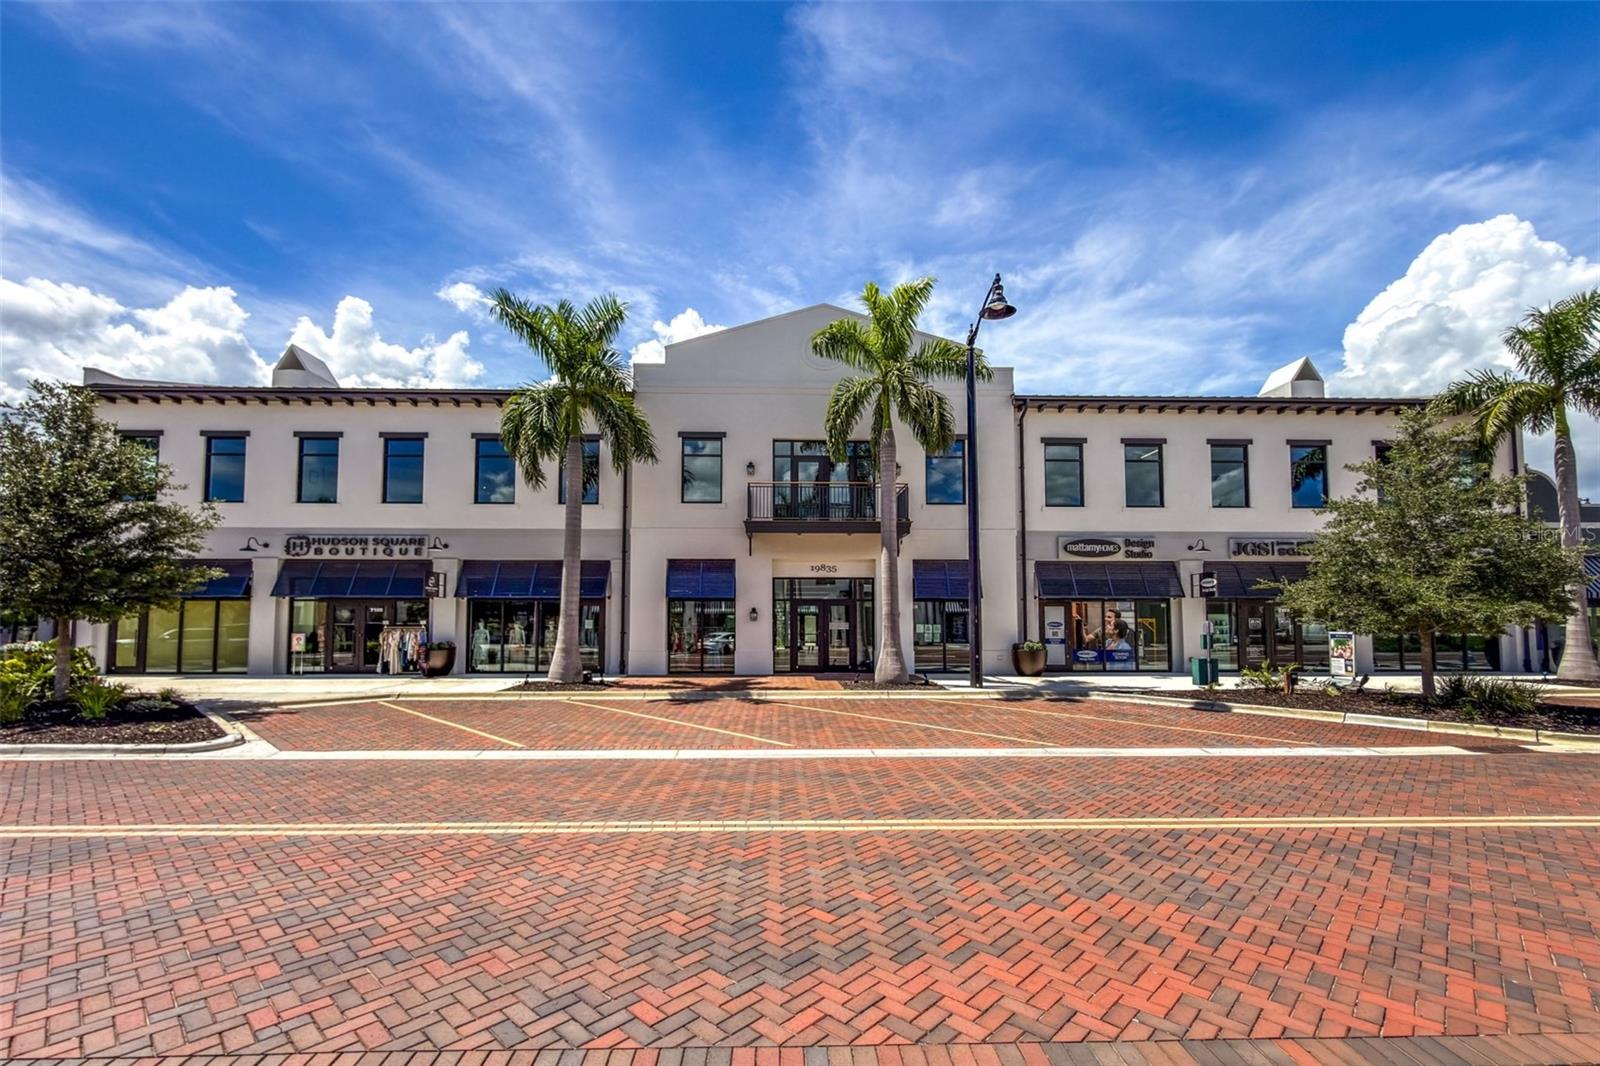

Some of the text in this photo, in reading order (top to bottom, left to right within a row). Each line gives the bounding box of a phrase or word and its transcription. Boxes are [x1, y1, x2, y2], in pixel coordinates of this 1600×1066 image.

[311, 537, 425, 547] HUDSON SQUARE
[1124, 538, 1155, 549] Design
[313, 547, 423, 557] BOUTIQUE
[1232, 541, 1270, 556] JGS
[1124, 549, 1153, 559] Studio
[810, 563, 838, 573] 19835
